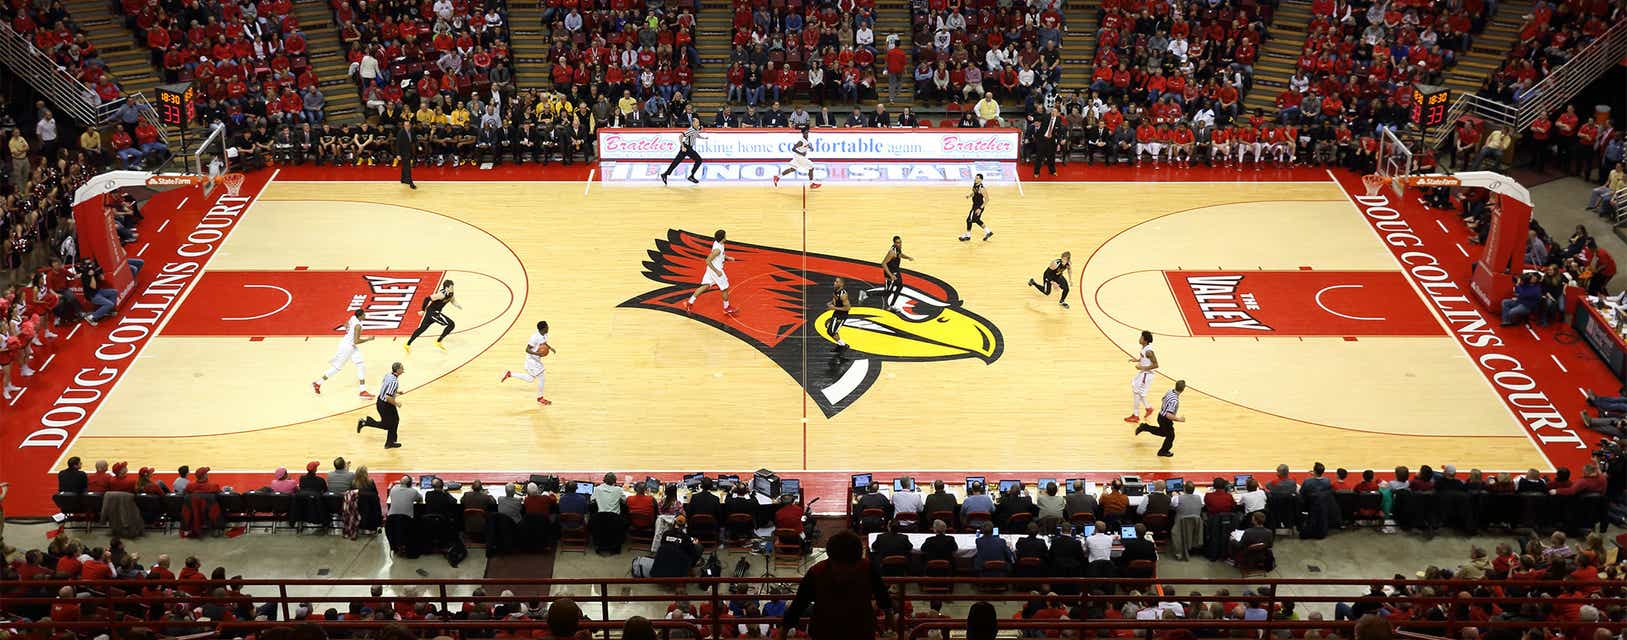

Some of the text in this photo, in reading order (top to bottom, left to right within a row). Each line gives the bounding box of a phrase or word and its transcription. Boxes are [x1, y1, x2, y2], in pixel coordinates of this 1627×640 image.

[161, 92, 180, 105] 18:30
[163, 104, 180, 124] 33
[1426, 105, 1444, 125] 33
[605, 135, 675, 151] Bratcher
[692, 139, 734, 156] aking
[738, 138, 774, 153] home
[778, 137, 884, 153] cofortable
[943, 135, 1011, 151] Bratcher
[347, 294, 368, 312] THE
[1186, 275, 1276, 331] VALLEY
[1240, 292, 1260, 310] THE
[18, 194, 251, 449] DOUG COLLINS COURT
[1354, 194, 1588, 450] DOUG COLLINS COURT
